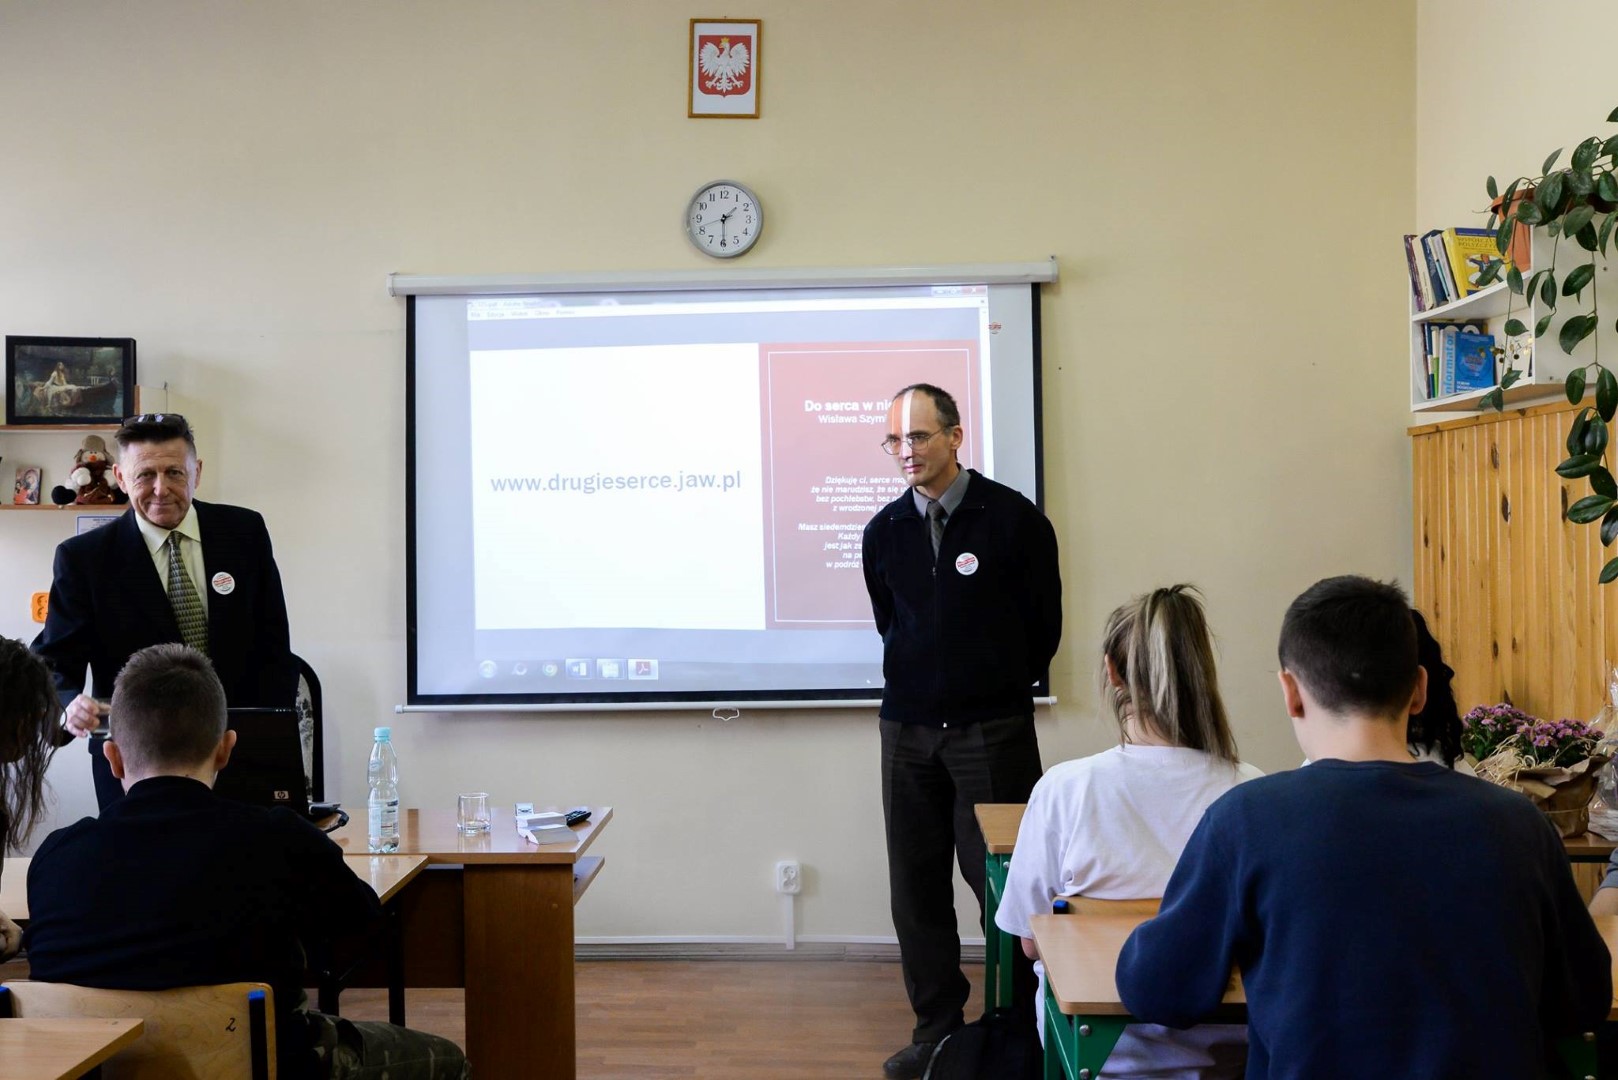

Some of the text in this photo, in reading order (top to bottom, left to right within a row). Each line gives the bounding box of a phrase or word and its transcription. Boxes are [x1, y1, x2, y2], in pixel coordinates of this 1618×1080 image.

[709, 193, 716, 202] 11
[720, 190, 729, 199] 12
[735, 194, 739, 202] 1
[699, 202, 708, 211] 10
[743, 203, 750, 212] 2
[696, 214, 702, 224] 9
[746, 215, 752, 224] 3
[699, 226, 706, 235] 8
[742, 228, 748, 236] 4
[708, 235, 714, 244] 7
[720, 239, 726, 248] 6
[733, 236, 740, 244] 5
[804, 400, 822, 412] Do
[824, 401, 860, 412] serca
[862, 401, 874, 411] w
[490, 470, 742, 494] www.drugieserce.jaw.pl
[825, 476, 858, 486] Dziękuję
[811, 486, 820, 494] że
[876, 486, 886, 494] że
[887, 486, 898, 494] się
[816, 495, 829, 503] bez
[839, 504, 877, 513] wrodzonej
[798, 523, 818, 531] Masz
[838, 532, 860, 542] Każdy
[823, 542, 840, 551] jest
[840, 542, 852, 551] jak
[834, 560, 860, 570] podróż
[226, 1017, 236, 1032] 2
